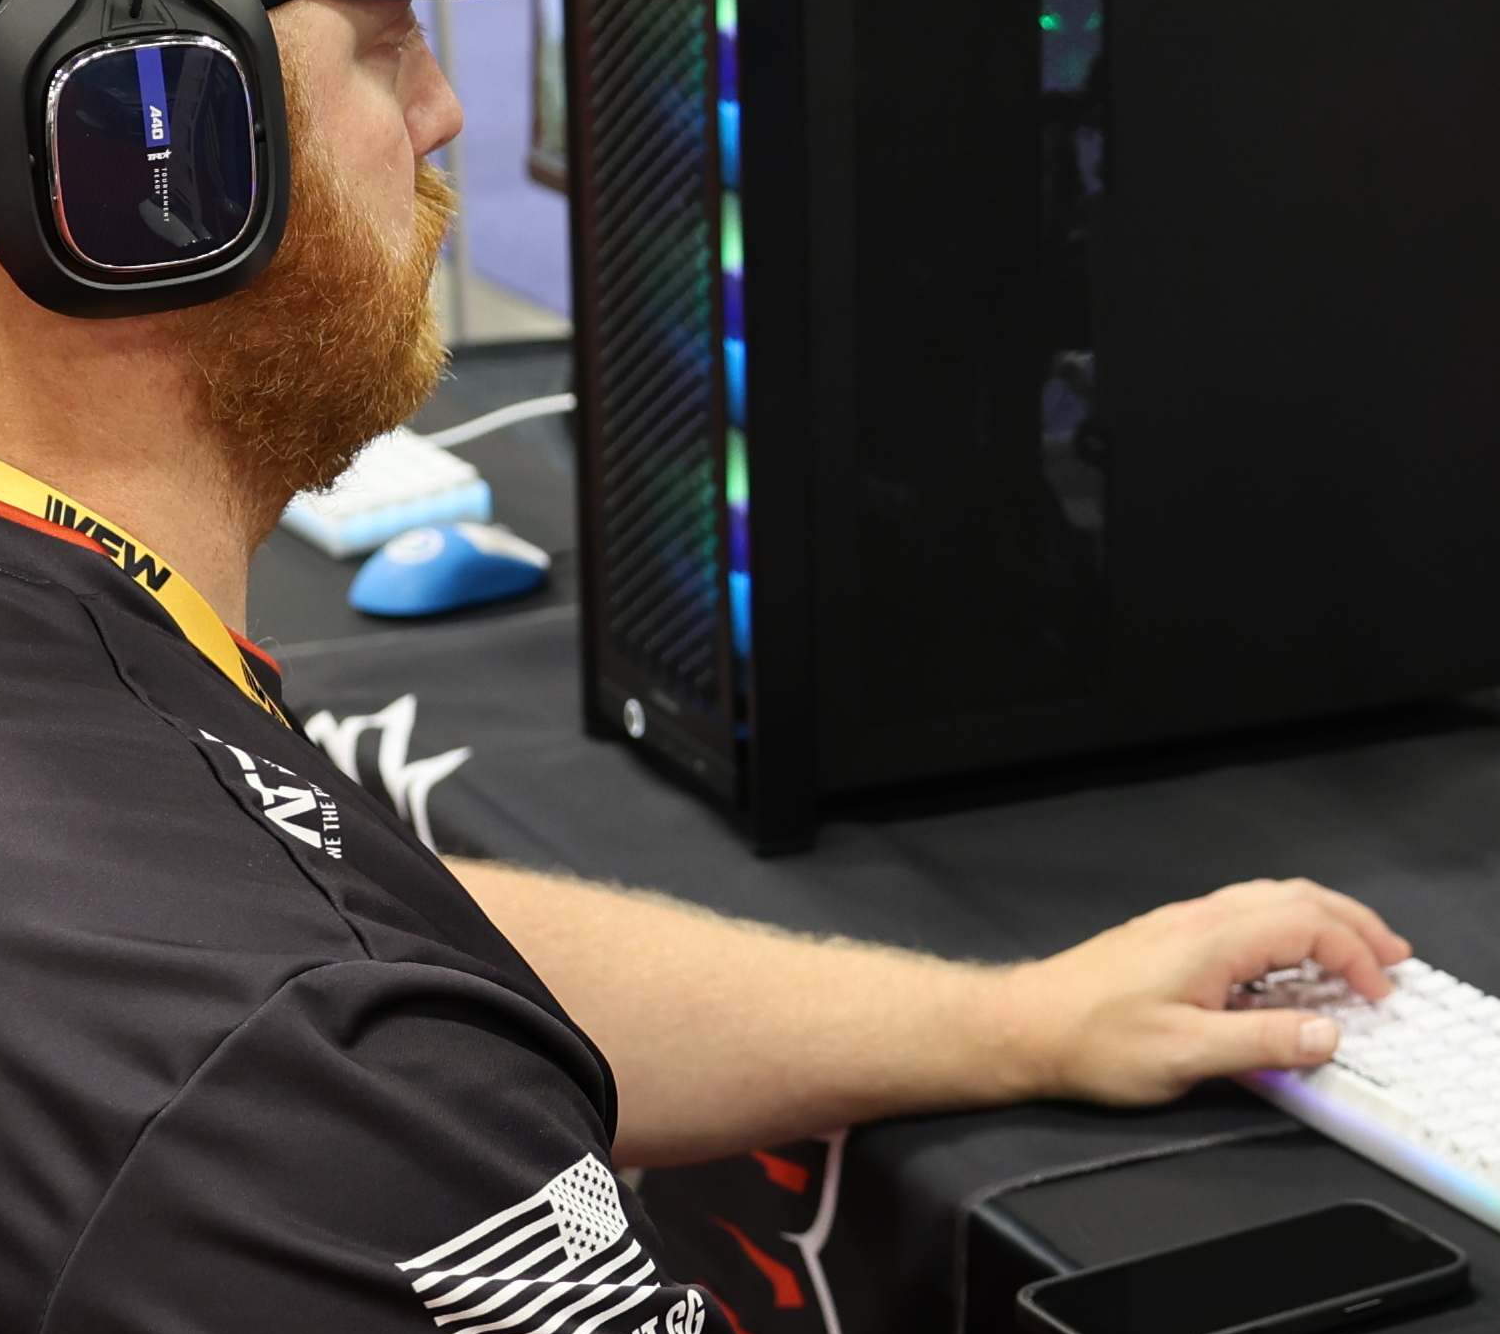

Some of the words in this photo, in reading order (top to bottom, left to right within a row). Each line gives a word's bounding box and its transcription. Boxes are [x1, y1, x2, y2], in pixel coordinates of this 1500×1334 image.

[149, 105, 164, 140] A40
[153, 168, 161, 195] READY
[161, 167, 170, 222] TOURNAMENT
[60, 503, 172, 592] VFW
[319, 800, 341, 831] THE
